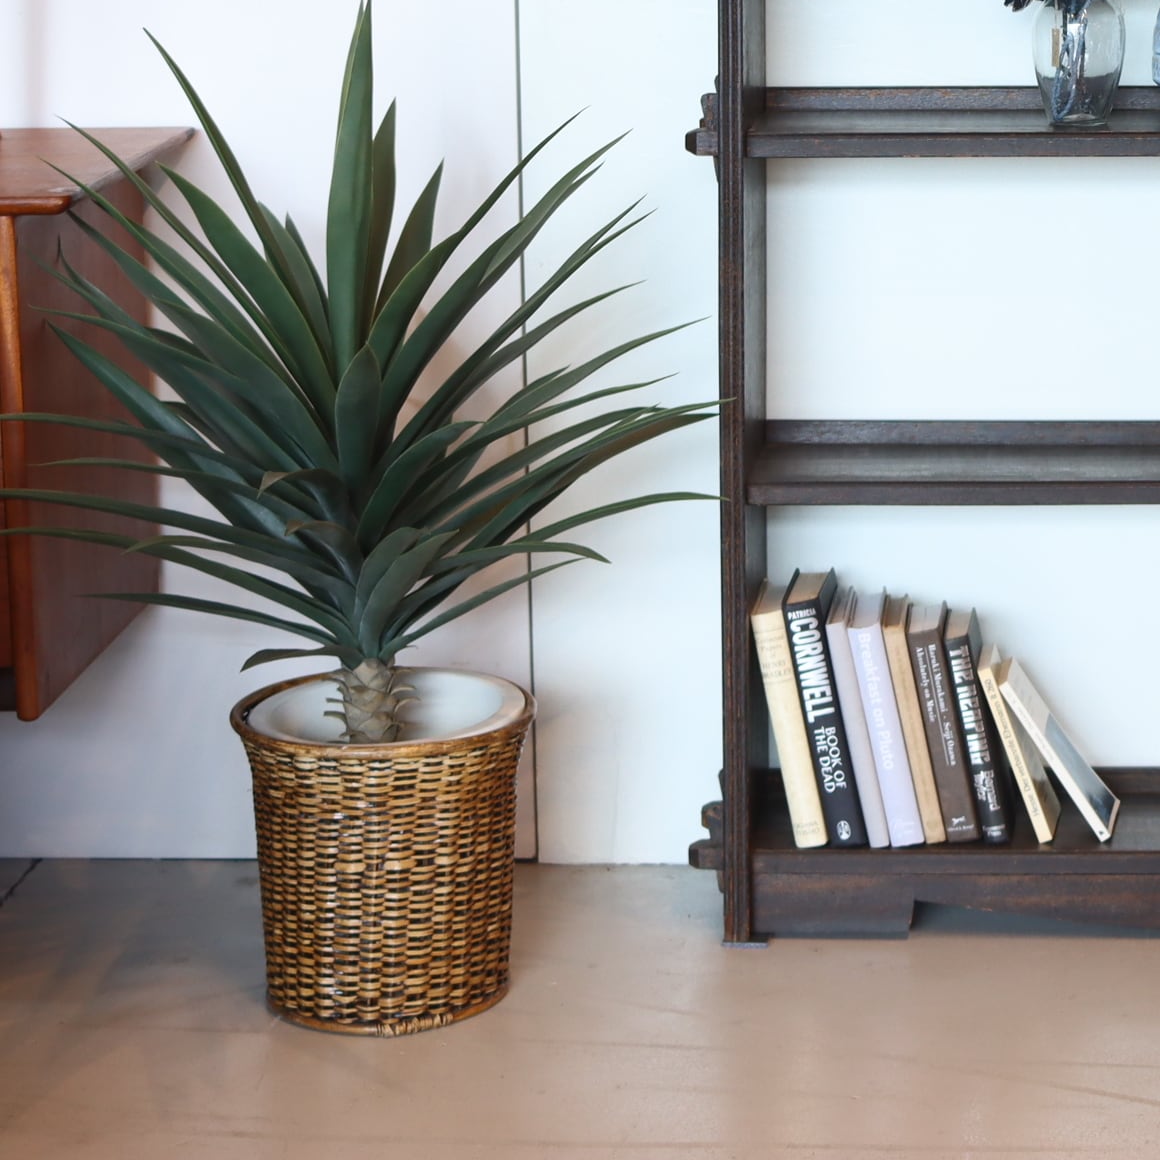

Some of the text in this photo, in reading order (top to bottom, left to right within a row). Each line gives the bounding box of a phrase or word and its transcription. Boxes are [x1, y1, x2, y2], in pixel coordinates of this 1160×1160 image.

[788, 608, 816, 620] PATRICIA
[790, 617, 835, 723] CORNWELL
[916, 647, 936, 722] Absolutely on Music
[949, 645, 974, 684] THE
[857, 633, 894, 769] Breakfast on Pluto
[928, 644, 939, 672] Haruki
[935, 672, 948, 712] Murakami
[947, 740, 957, 766] Ozawa
[814, 726, 836, 793] THE DEAD
[825, 727, 847, 789] BOOK OF
[983, 769, 1000, 812] Bernard
